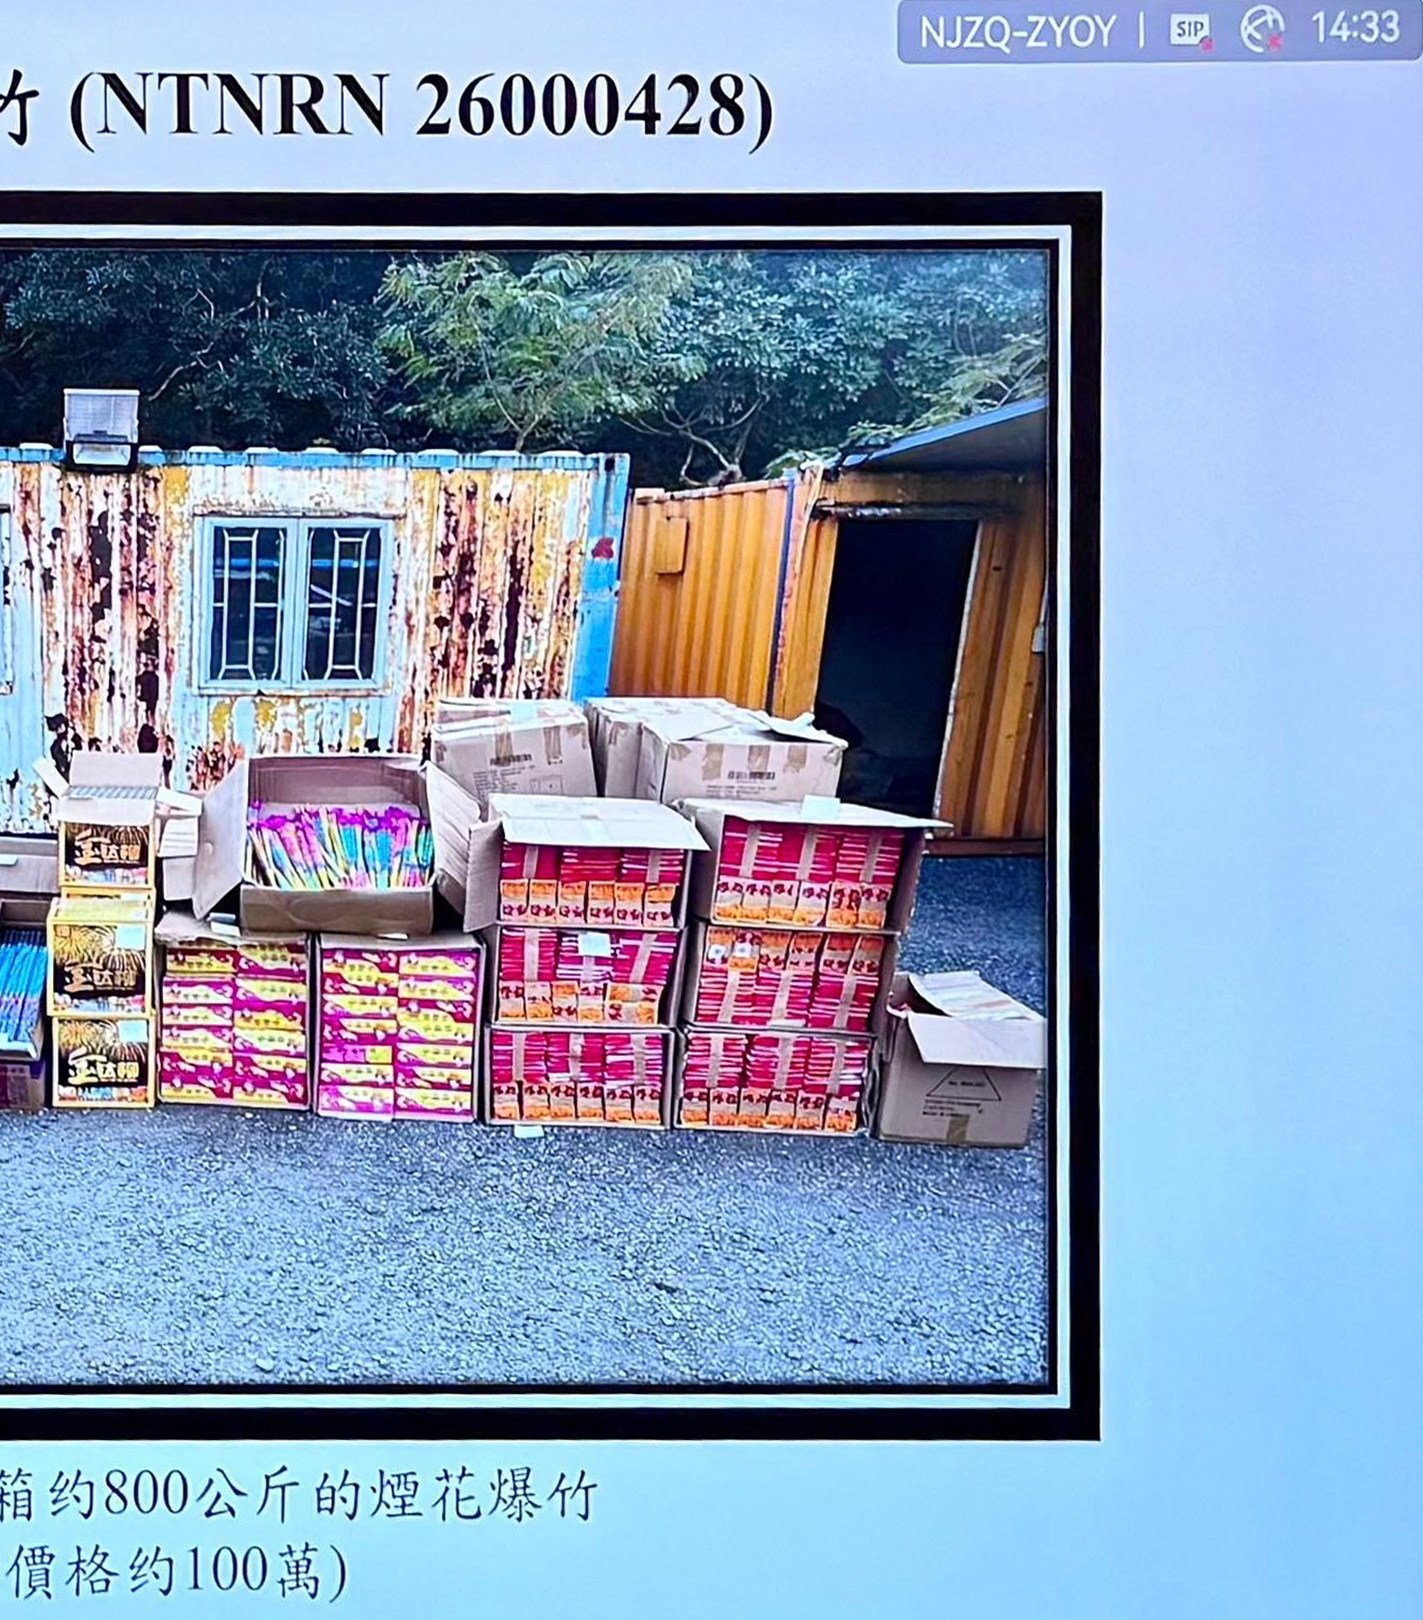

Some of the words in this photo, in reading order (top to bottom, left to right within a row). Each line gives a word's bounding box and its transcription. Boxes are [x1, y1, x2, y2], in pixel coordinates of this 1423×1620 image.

[921, 14, 1118, 54] NJZQ-ZYOY
[1176, 20, 1205, 38] SIP
[1312, 9, 1400, 43] 14:33
[70, 72, 390, 153] (NTNRN
[416, 73, 773, 154] 26000428)
